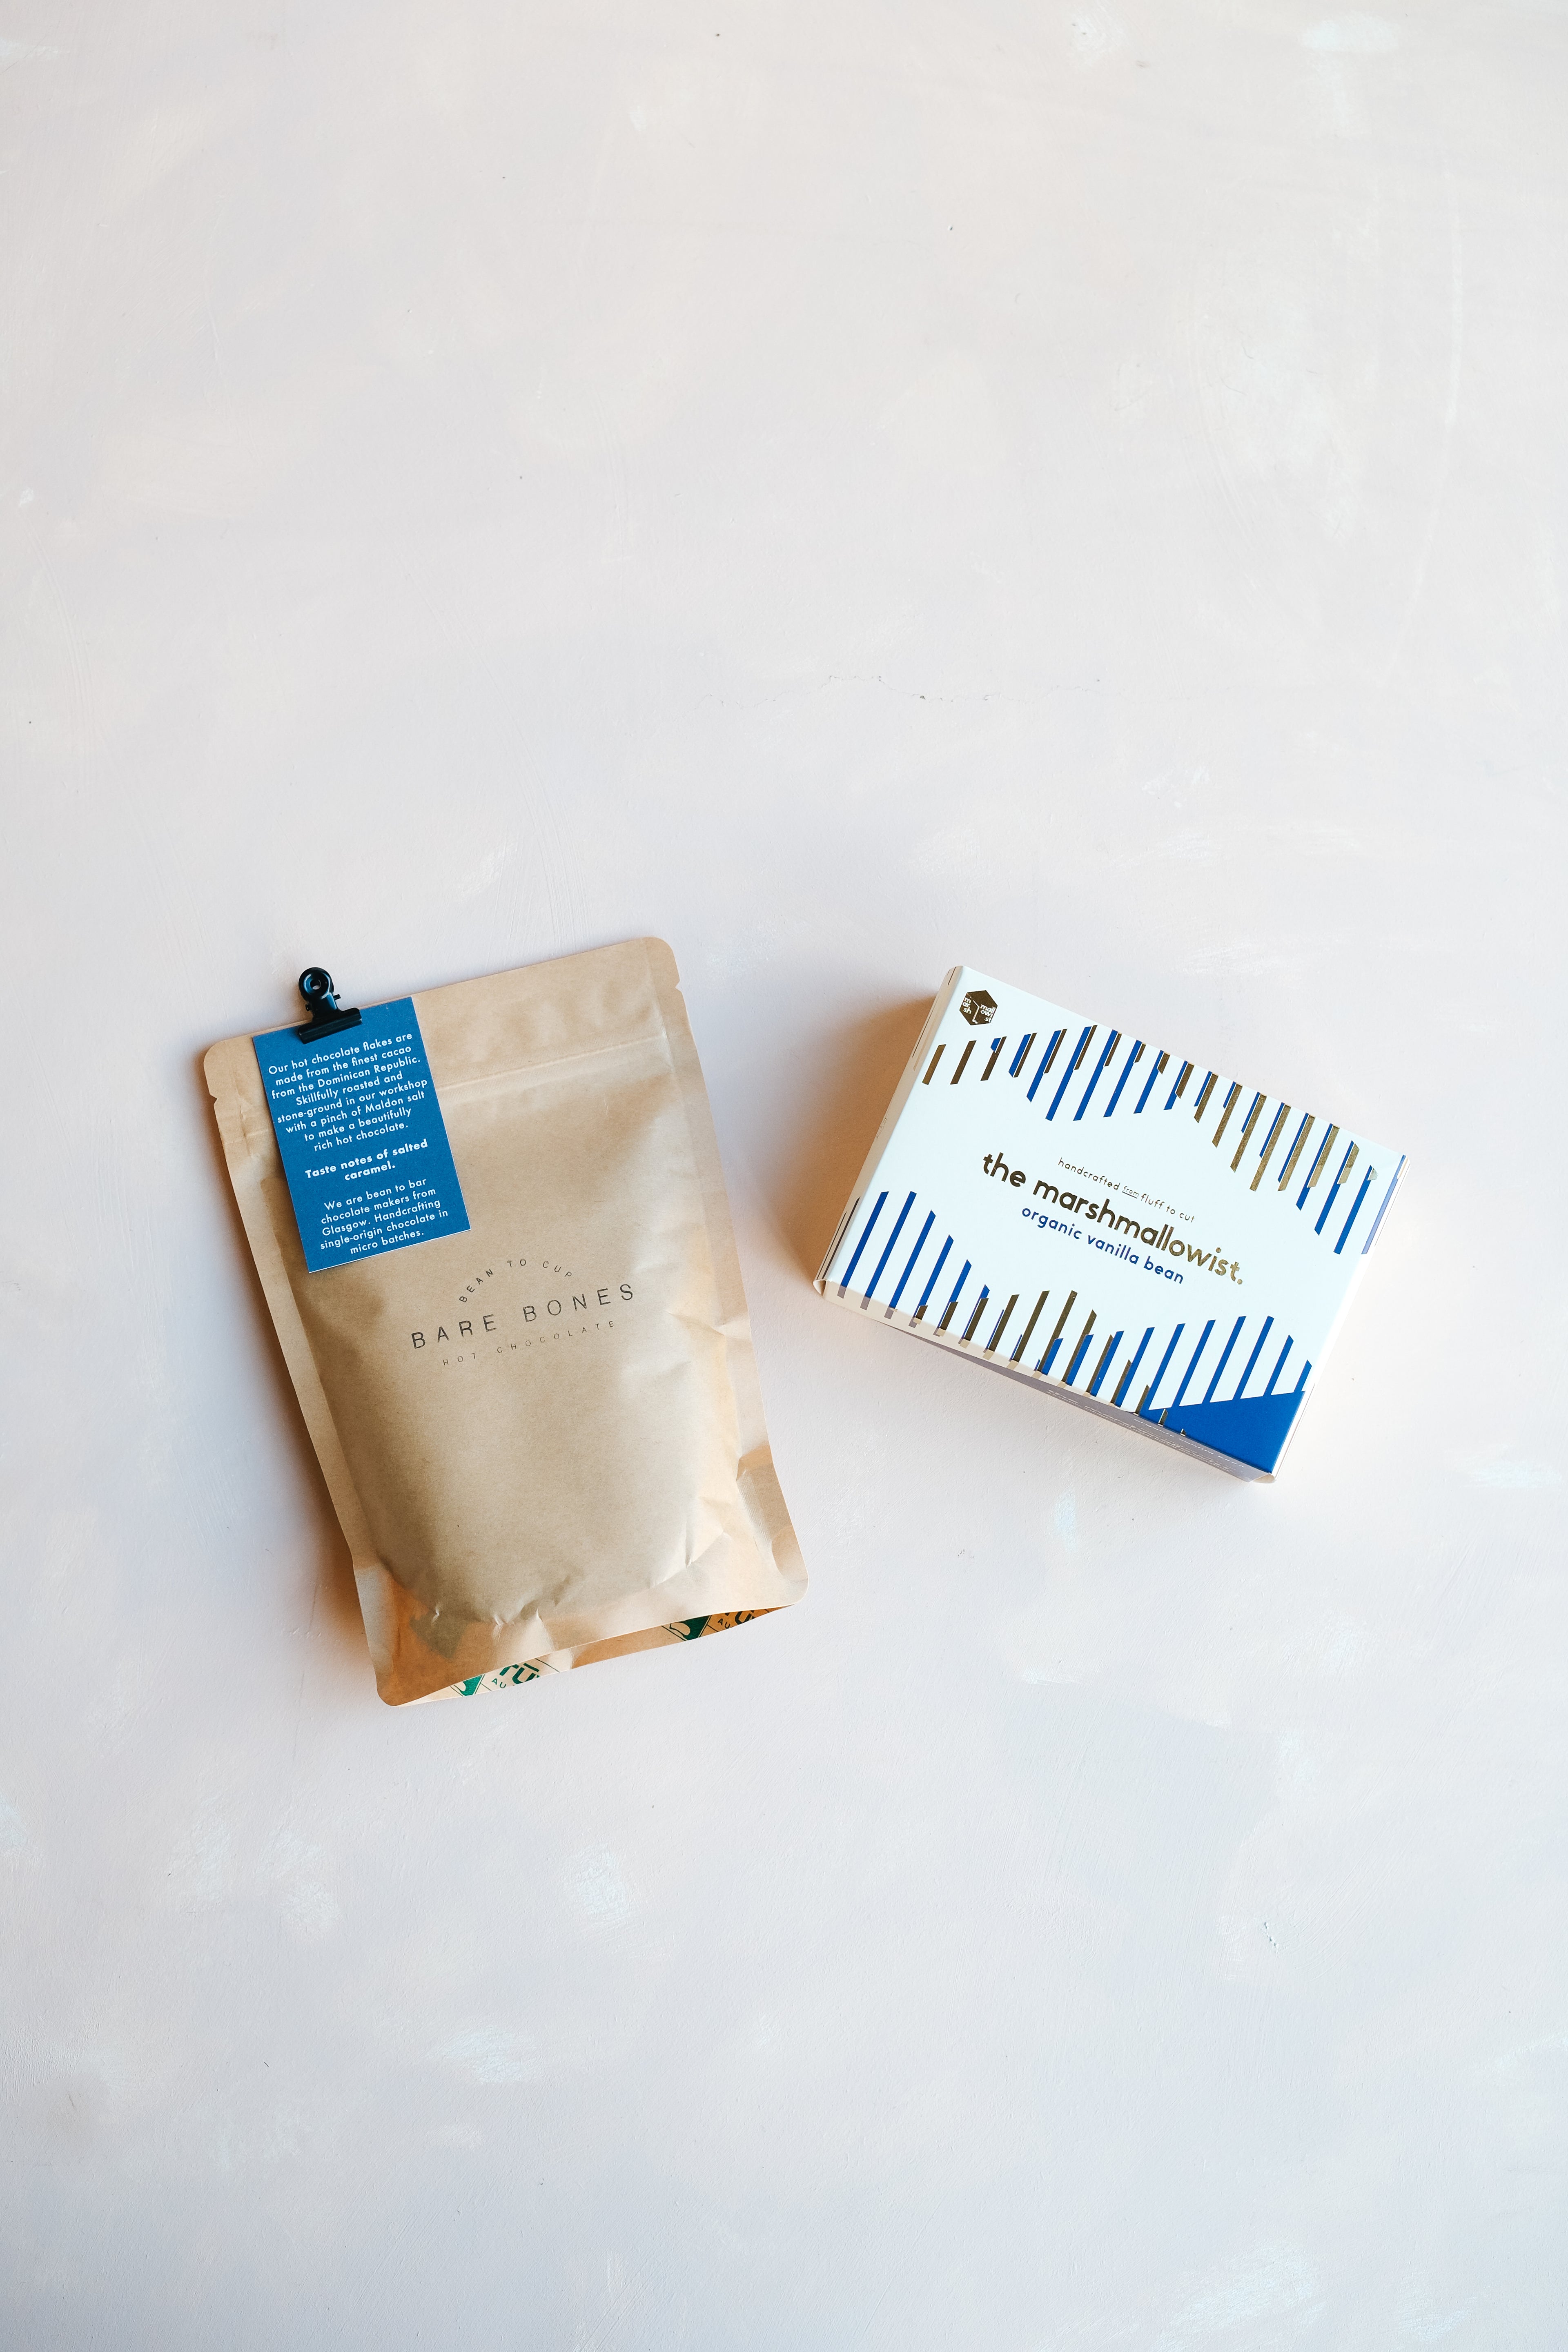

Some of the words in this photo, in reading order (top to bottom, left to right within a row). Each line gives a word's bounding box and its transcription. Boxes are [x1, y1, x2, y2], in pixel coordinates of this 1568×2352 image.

[268, 1065, 288, 1074] Our
[291, 1058, 307, 1069] hot
[312, 1047, 360, 1064] chocolate
[363, 1038, 392, 1051] flakes
[396, 1033, 412, 1042] are
[275, 1072, 303, 1086] made
[306, 1067, 330, 1078] from
[332, 1061, 348, 1071] the
[352, 1053, 378, 1067] finest
[381, 1046, 411, 1058] cacao
[272, 1089, 295, 1099] from
[298, 1082, 314, 1092] the
[317, 1069, 370, 1087] Dominican
[374, 1056, 420, 1073] Republic.
[296, 1088, 338, 1105] Skillfully
[342, 1076, 380, 1094] roasted
[384, 1070, 403, 1083] and
[277, 1098, 343, 1123] stone-ground
[345, 1097, 355, 1106] in
[359, 1093, 375, 1102] our
[379, 1080, 427, 1096] workshop
[285, 1120, 307, 1133] with
[321, 1110, 347, 1127] pinch
[351, 1106, 361, 1116] of
[365, 1098, 403, 1113] Maldon
[407, 1090, 424, 1102] salt
[314, 1139, 333, 1152] rich
[336, 1135, 352, 1145] hot
[356, 1123, 408, 1140] chocolate.
[318, 1125, 345, 1138] make
[358, 1107, 411, 1127] beautifully
[305, 1165, 336, 1178] Taste
[341, 1156, 372, 1169] notes
[376, 1149, 388, 1160] of
[392, 1138, 428, 1156] salted
[345, 1160, 396, 1180] caramel.
[321, 1207, 370, 1224] chocolate
[374, 1196, 410, 1210] makers
[412, 1189, 436, 1200] from
[324, 1200, 342, 1210] We
[346, 1196, 363, 1205] are
[366, 1188, 392, 1200] bean
[408, 1179, 426, 1189] bar
[1058, 1157, 1121, 1190] handcrafted
[1123, 1185, 1139, 1197] from
[1140, 1193, 1165, 1209] fluff
[1166, 1205, 1176, 1214] to
[1179, 1213, 1195, 1223] cut
[321, 1227, 383, 1250] single-origin
[386, 1214, 435, 1232] chocolate
[438, 1209, 448, 1218] in
[322, 1220, 370, 1236] Glasgow.
[374, 1200, 441, 1223] Handcrafting
[983, 1152, 1026, 1187] the
[1033, 1179, 1243, 1285] marshmallowist.
[350, 1242, 378, 1254] micro
[381, 1230, 424, 1245] batches.
[1022, 1208, 1082, 1240] organic
[1088, 1235, 1140, 1264] vanilla
[1143, 1255, 1183, 1284] bean
[459, 1269, 493, 1303] BEAN
[507, 1259, 527, 1268] TO
[543, 1261, 572, 1278] CUP
[411, 1314, 497, 1349] BARE
[523, 1284, 633, 1322] BONES
[443, 1353, 477, 1365] HOT
[497, 1321, 615, 1354] CHOCOLATE
